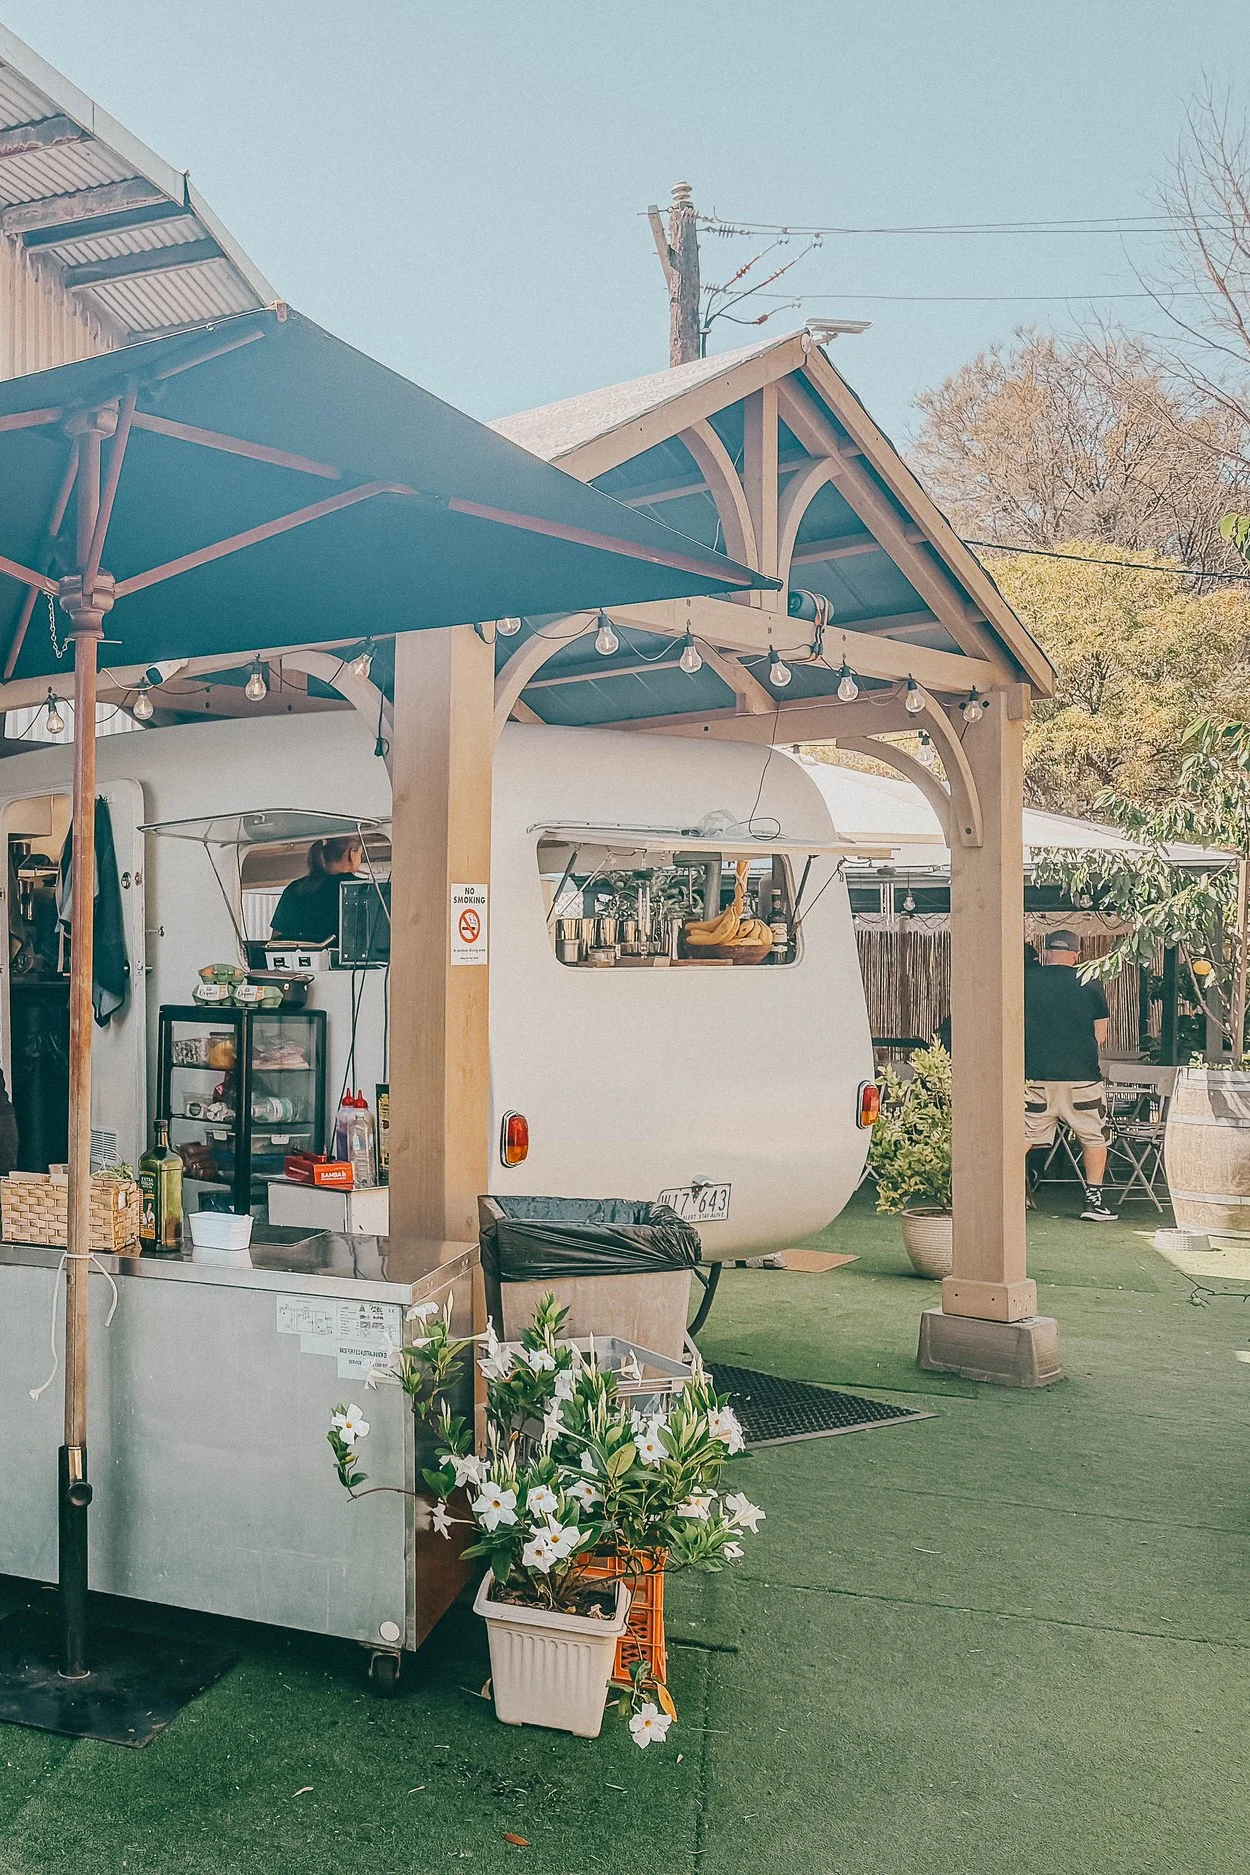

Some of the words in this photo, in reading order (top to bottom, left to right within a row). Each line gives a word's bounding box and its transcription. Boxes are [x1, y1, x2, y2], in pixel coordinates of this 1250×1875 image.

[464, 887, 475, 895] NO
[453, 896, 486, 905] SMOKING
[698, 1189, 727, 1213] 643
